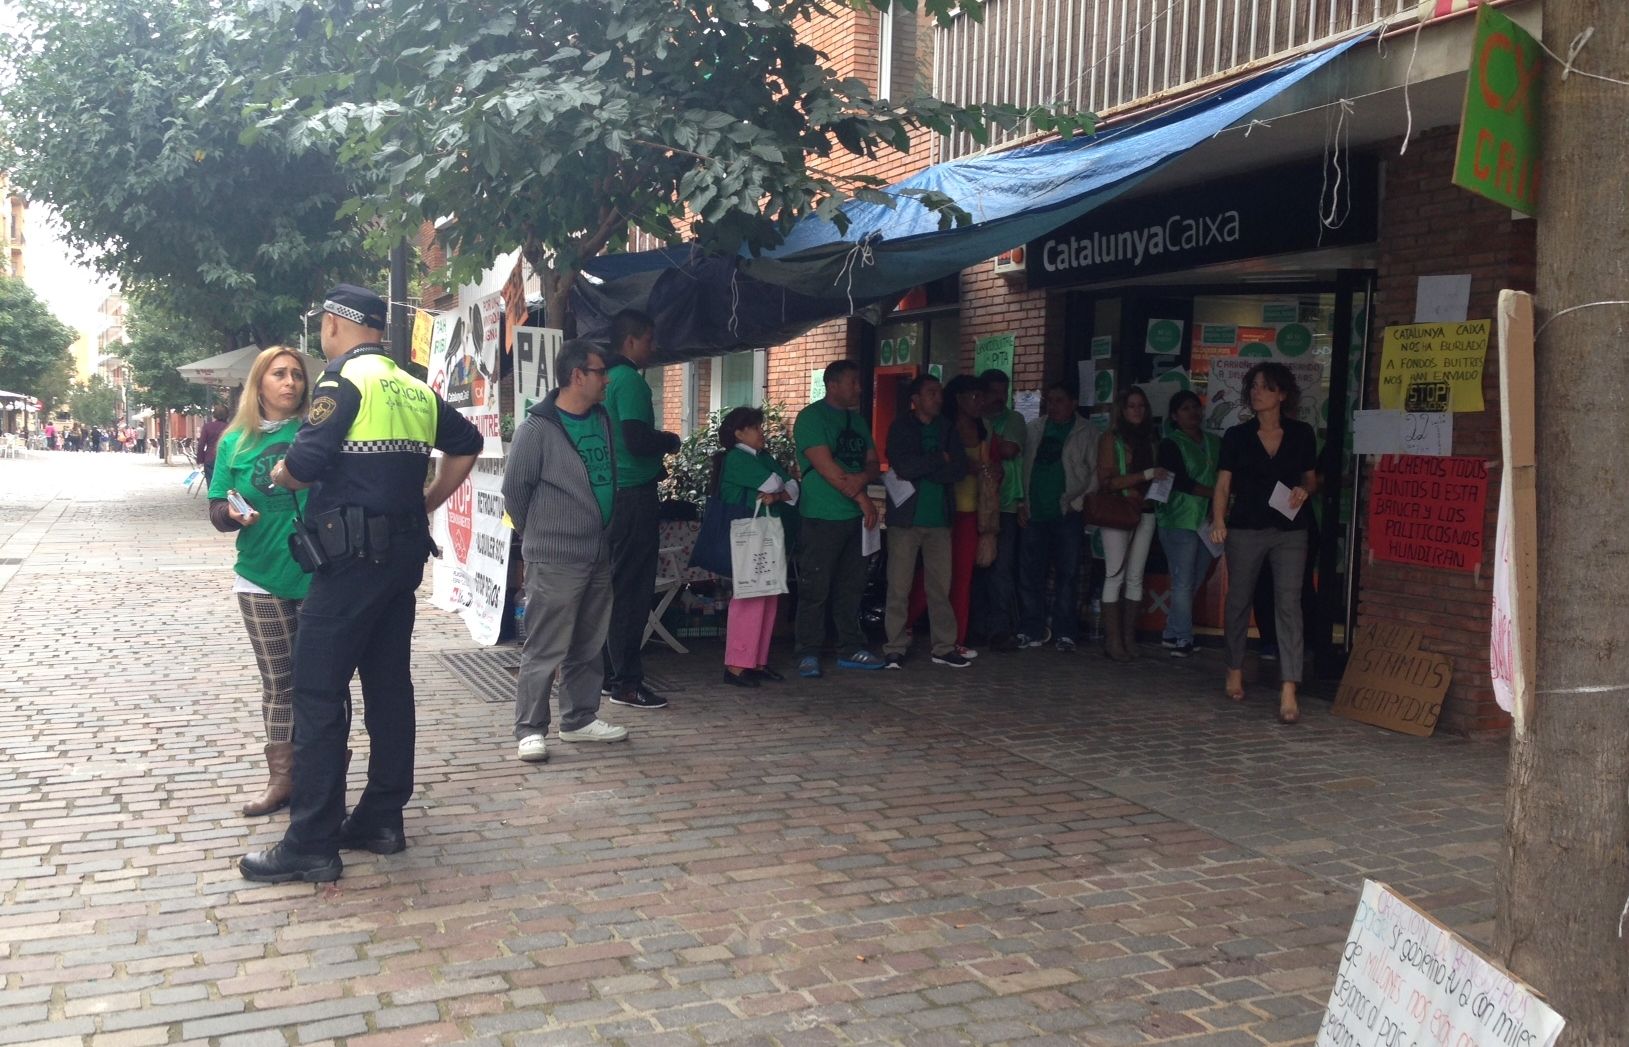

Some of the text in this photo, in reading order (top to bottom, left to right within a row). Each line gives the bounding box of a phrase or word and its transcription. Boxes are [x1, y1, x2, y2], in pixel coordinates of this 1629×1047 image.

[1043, 210, 1240, 272] CatalunyaCaixa
[1393, 322, 1486, 341] CATALUNYA CAIXA
[1401, 341, 1421, 353] NOS
[1386, 357, 1484, 370] A FONDOS BUITRES
[1383, 369, 1480, 385] NOS HAN ENVIADO
[1409, 383, 1447, 402] STOP
[1380, 454, 1488, 480] LUCHEMOS TODOS
[1374, 476, 1480, 502] JUNTOS O ESTA
[1375, 498, 1421, 518] BANCA
[1437, 507, 1466, 523] LOS
[1388, 540, 1466, 568] HUNDIRAN
